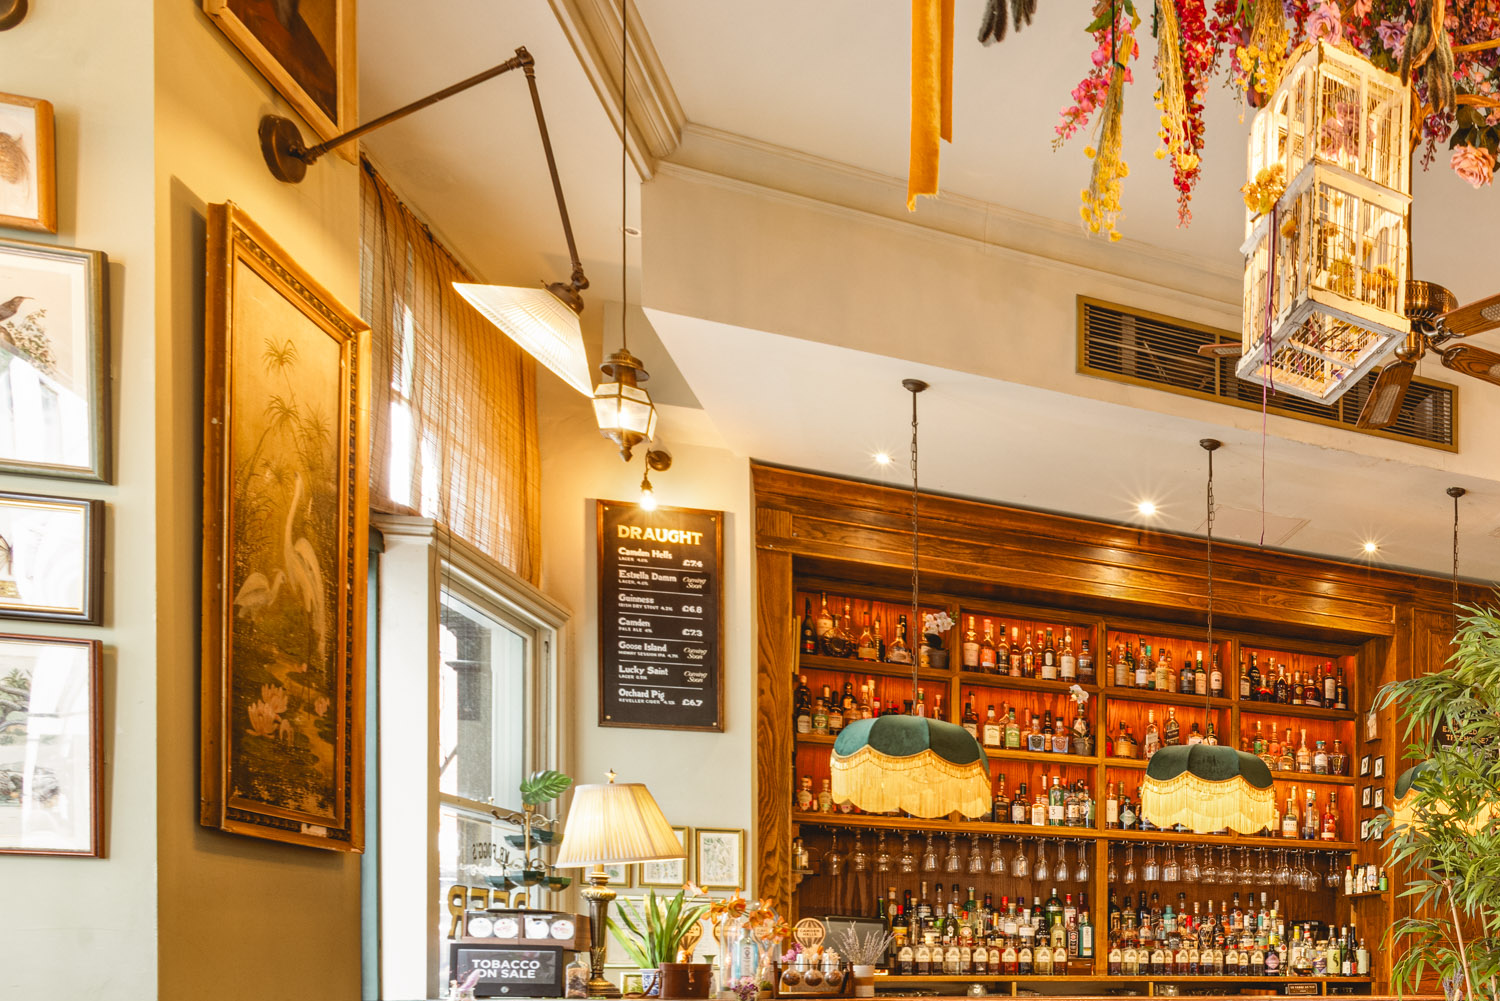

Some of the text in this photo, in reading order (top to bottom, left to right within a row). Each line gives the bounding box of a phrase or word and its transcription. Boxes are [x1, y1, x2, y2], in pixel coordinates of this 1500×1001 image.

[617, 525, 703, 545] DRAUGHT
[618, 547, 673, 559] Camden Hells
[682, 559, 703, 568] £7.4
[618, 569, 677, 582] Estrella Damm
[682, 576, 707, 585] Coming
[618, 593, 654, 604] Guinness
[682, 605, 702, 614] £6.8
[618, 617, 650, 627] Camden
[682, 628, 703, 637] £7.3
[618, 640, 667, 652] Goose Island
[683, 647, 708, 656] Coming
[618, 665, 669, 676] Lucky Saint
[683, 670, 708, 679] Coming
[618, 687, 665, 702] Orchard Pig
[682, 698, 703, 707] £6.7
[472, 959, 540, 970] TOBACCO
[478, 969, 536, 979] ON SALE
